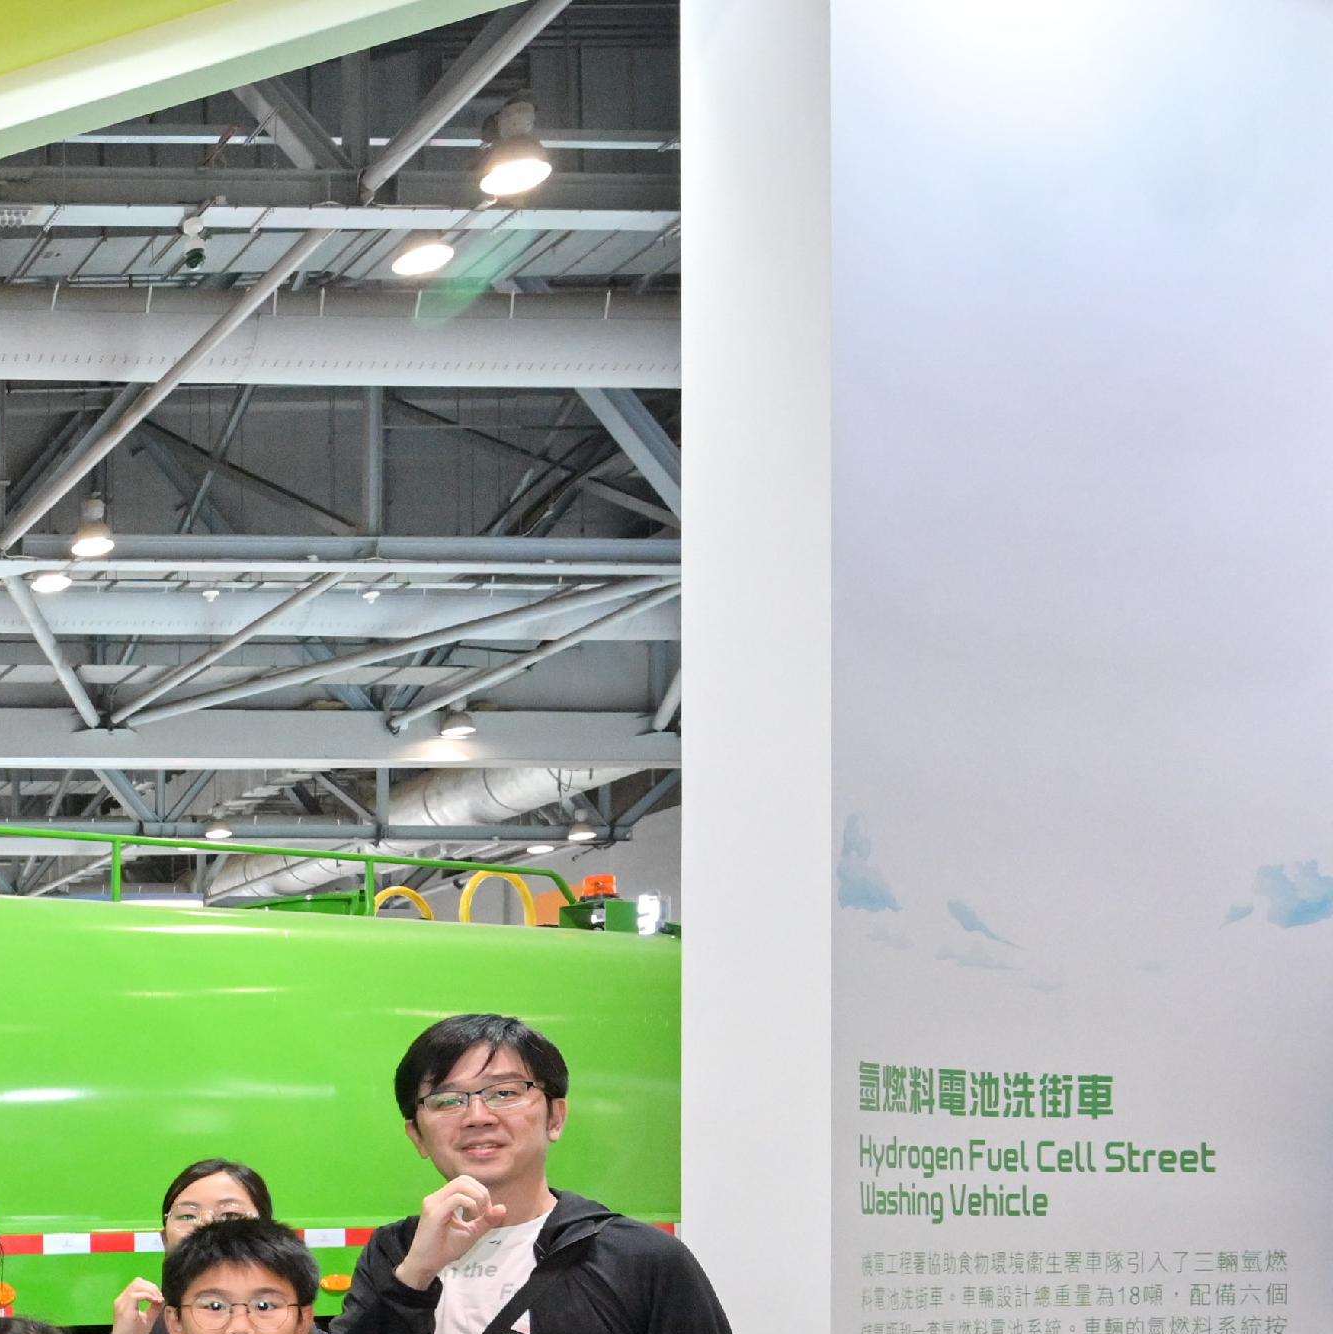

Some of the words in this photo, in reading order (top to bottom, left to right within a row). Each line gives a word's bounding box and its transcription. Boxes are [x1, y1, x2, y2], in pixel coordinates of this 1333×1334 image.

[859, 1060, 1114, 1120] 氫燃料電池洗街車
[859, 1135, 964, 1179] Hydrogen
[969, 1139, 1030, 1173] Fuel
[1036, 1140, 1097, 1174] Cell
[1104, 1141, 1217, 1174] Street
[860, 1181, 944, 1225] Washing
[949, 1183, 1049, 1218] Vehicle
